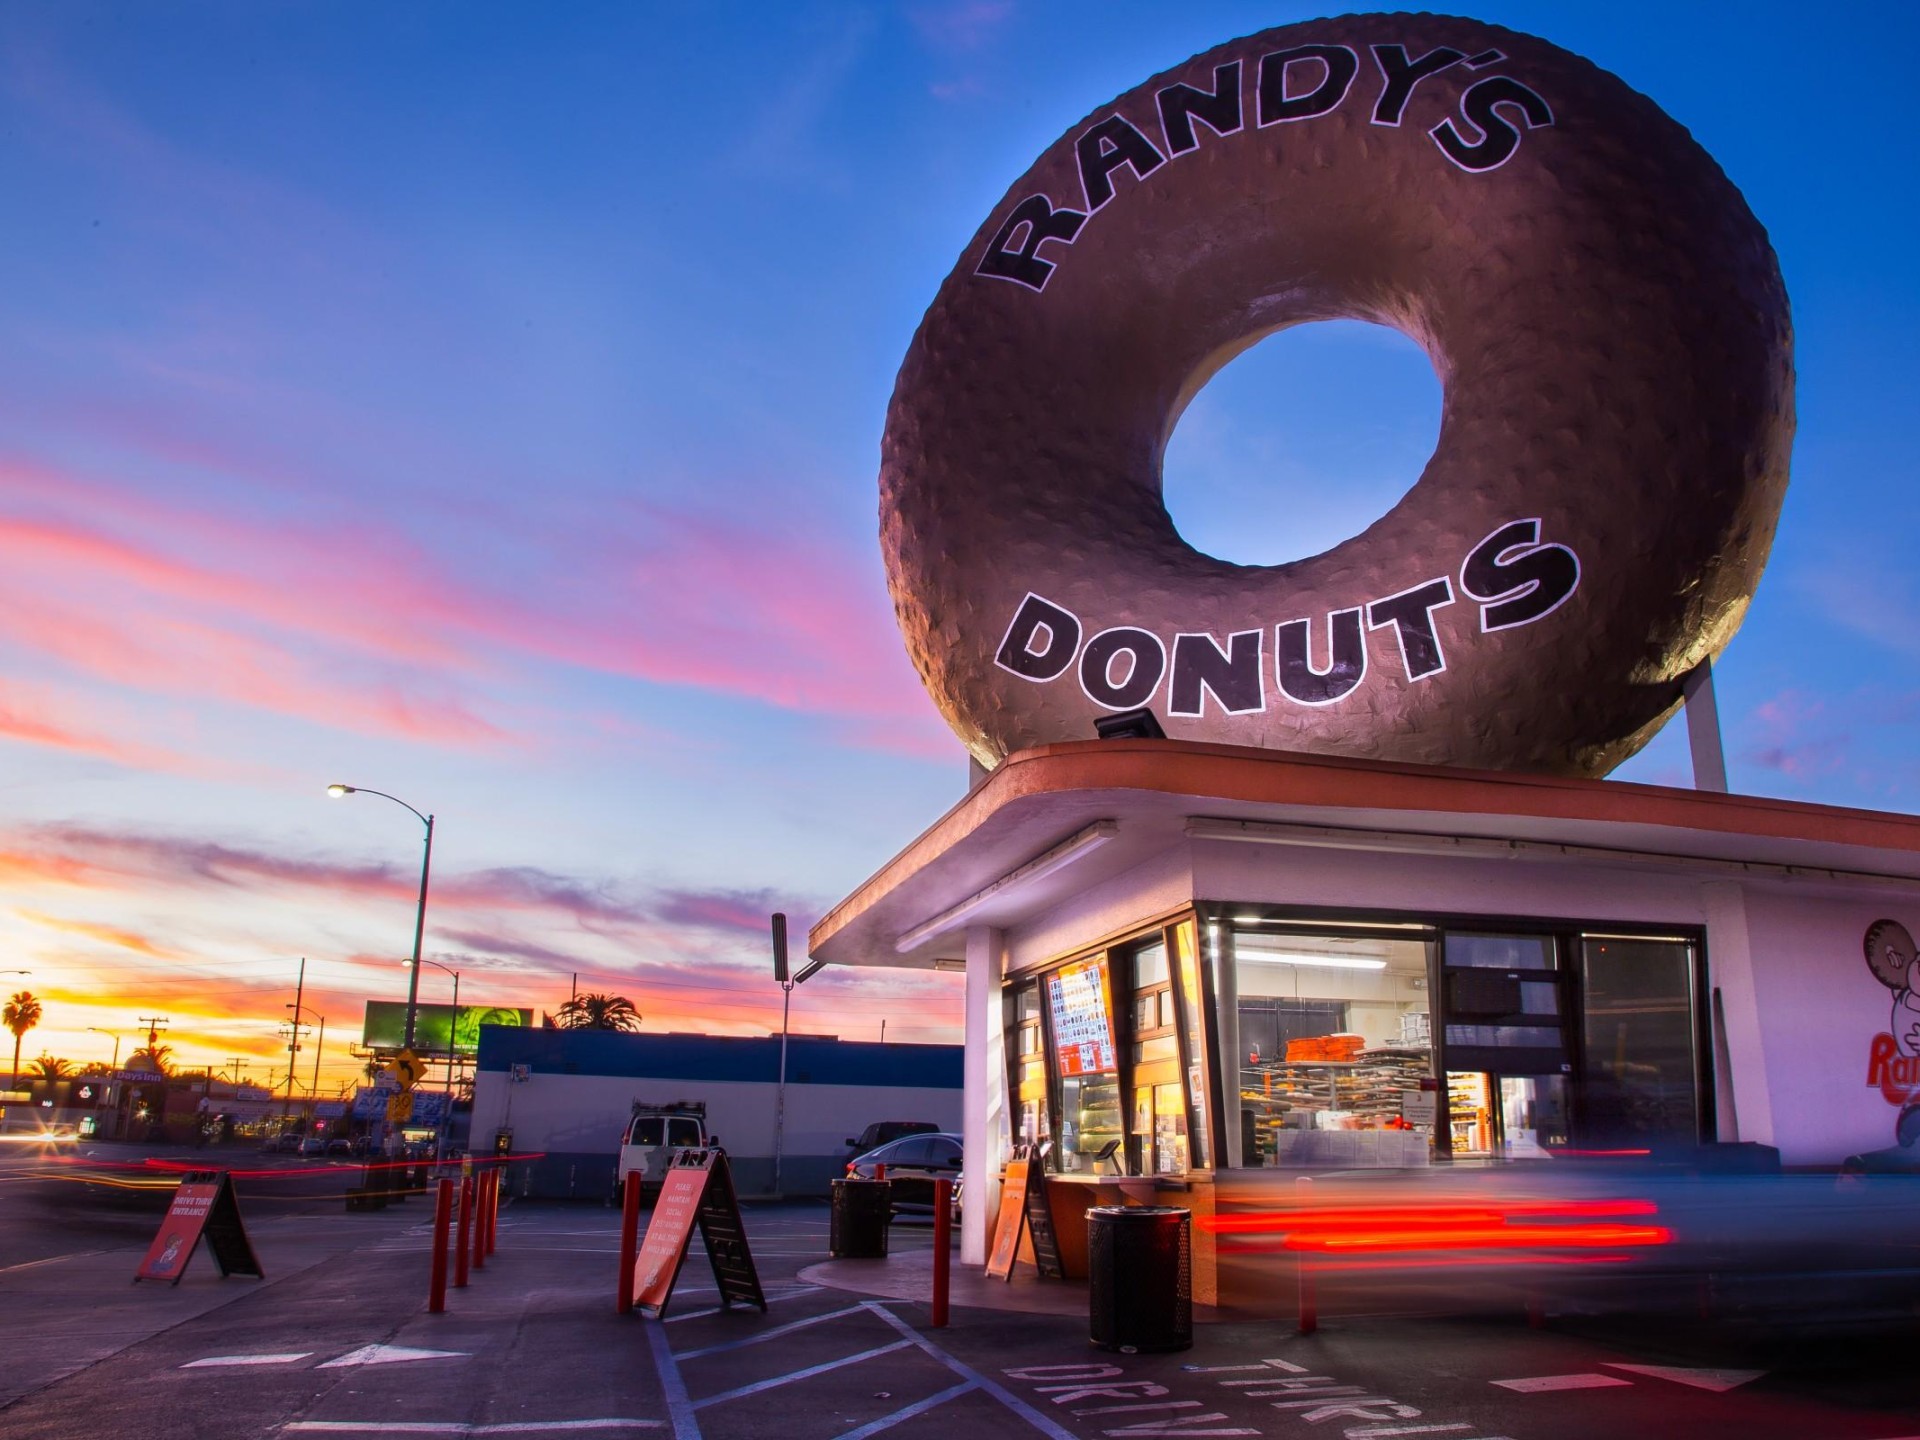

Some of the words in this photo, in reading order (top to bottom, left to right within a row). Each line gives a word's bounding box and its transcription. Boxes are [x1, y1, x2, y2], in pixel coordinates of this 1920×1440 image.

[974, 44, 1554, 292] RANDY'S
[994, 517, 1581, 717] DONUTS
[116, 1071, 142, 1082] Days
[143, 1073, 161, 1081] Inn
[174, 1197, 195, 1205] DRIVE
[171, 1207, 206, 1216] ENTRANCE
